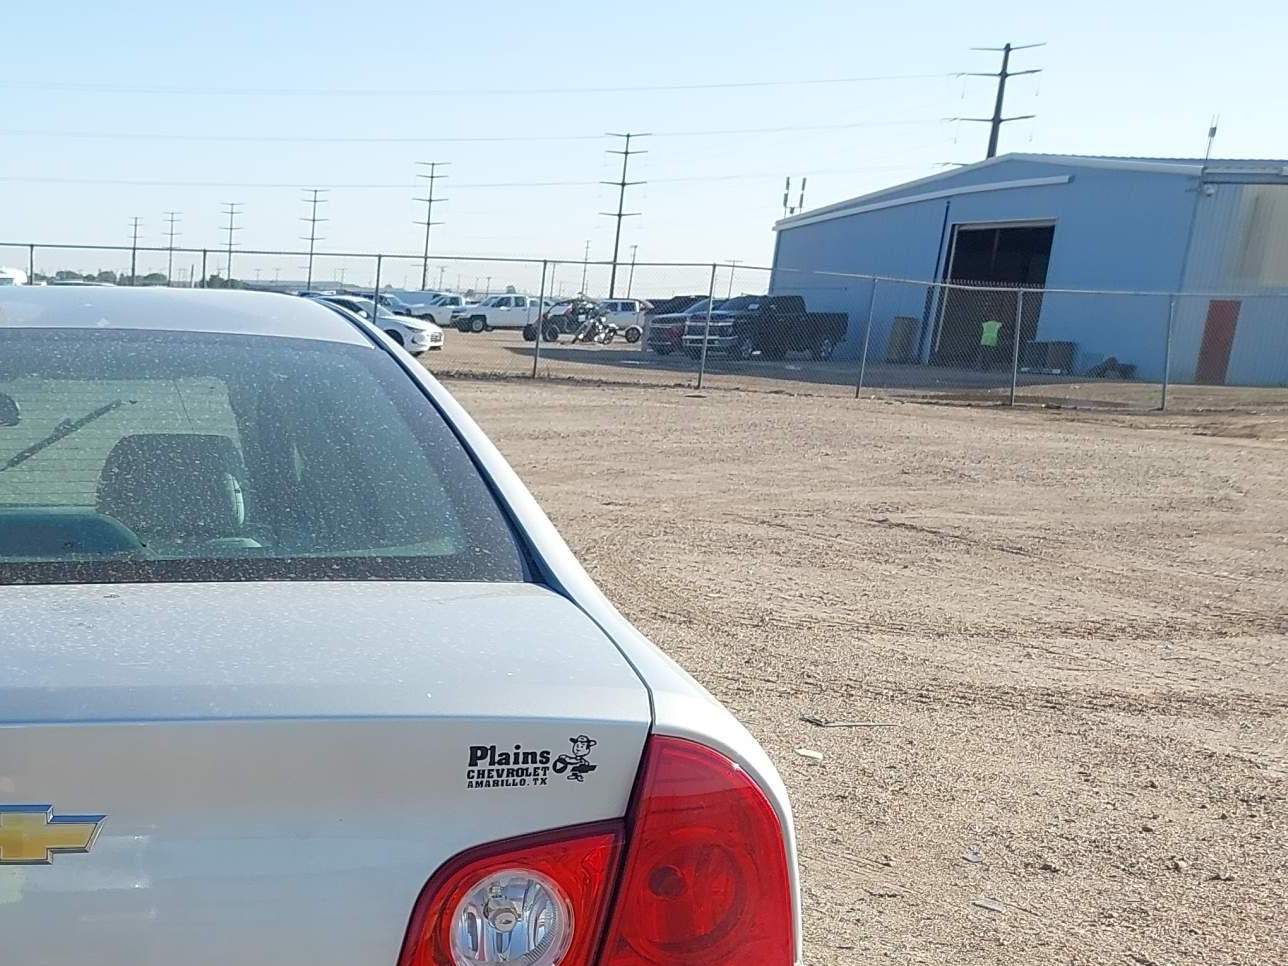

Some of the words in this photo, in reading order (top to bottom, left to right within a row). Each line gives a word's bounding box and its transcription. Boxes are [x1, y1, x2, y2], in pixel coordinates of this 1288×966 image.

[468, 744, 551, 767] Plains
[467, 767, 549, 780] CHEVROLET
[533, 777, 548, 786] TX
